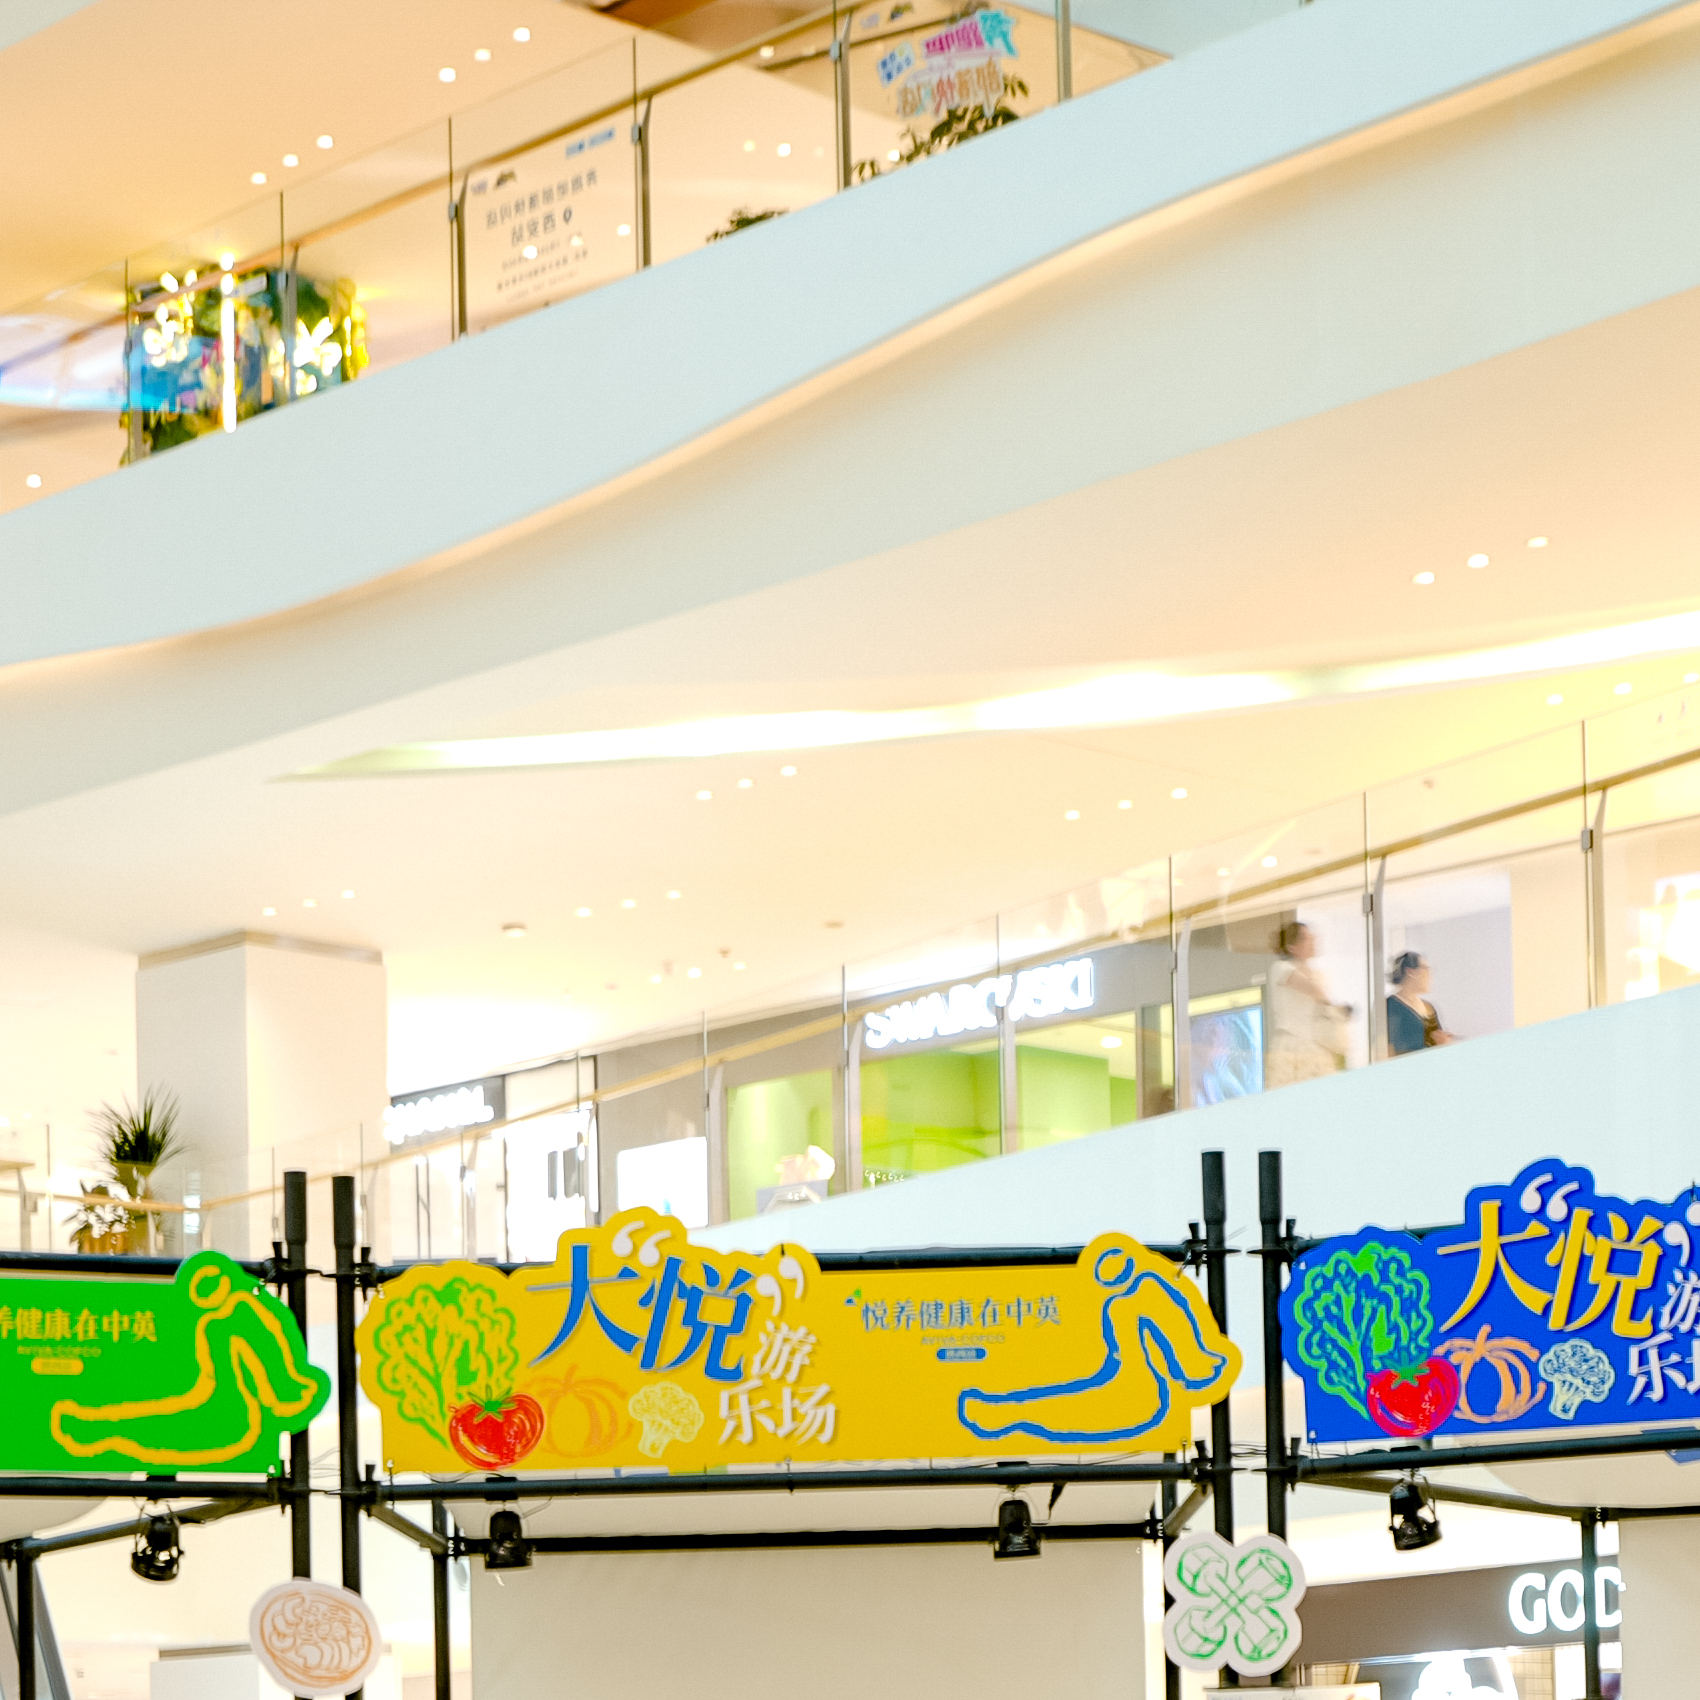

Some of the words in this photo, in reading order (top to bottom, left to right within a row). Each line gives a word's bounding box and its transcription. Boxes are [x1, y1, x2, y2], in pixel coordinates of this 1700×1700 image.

[861, 1295, 1062, 1333] 悦养健康在中英
